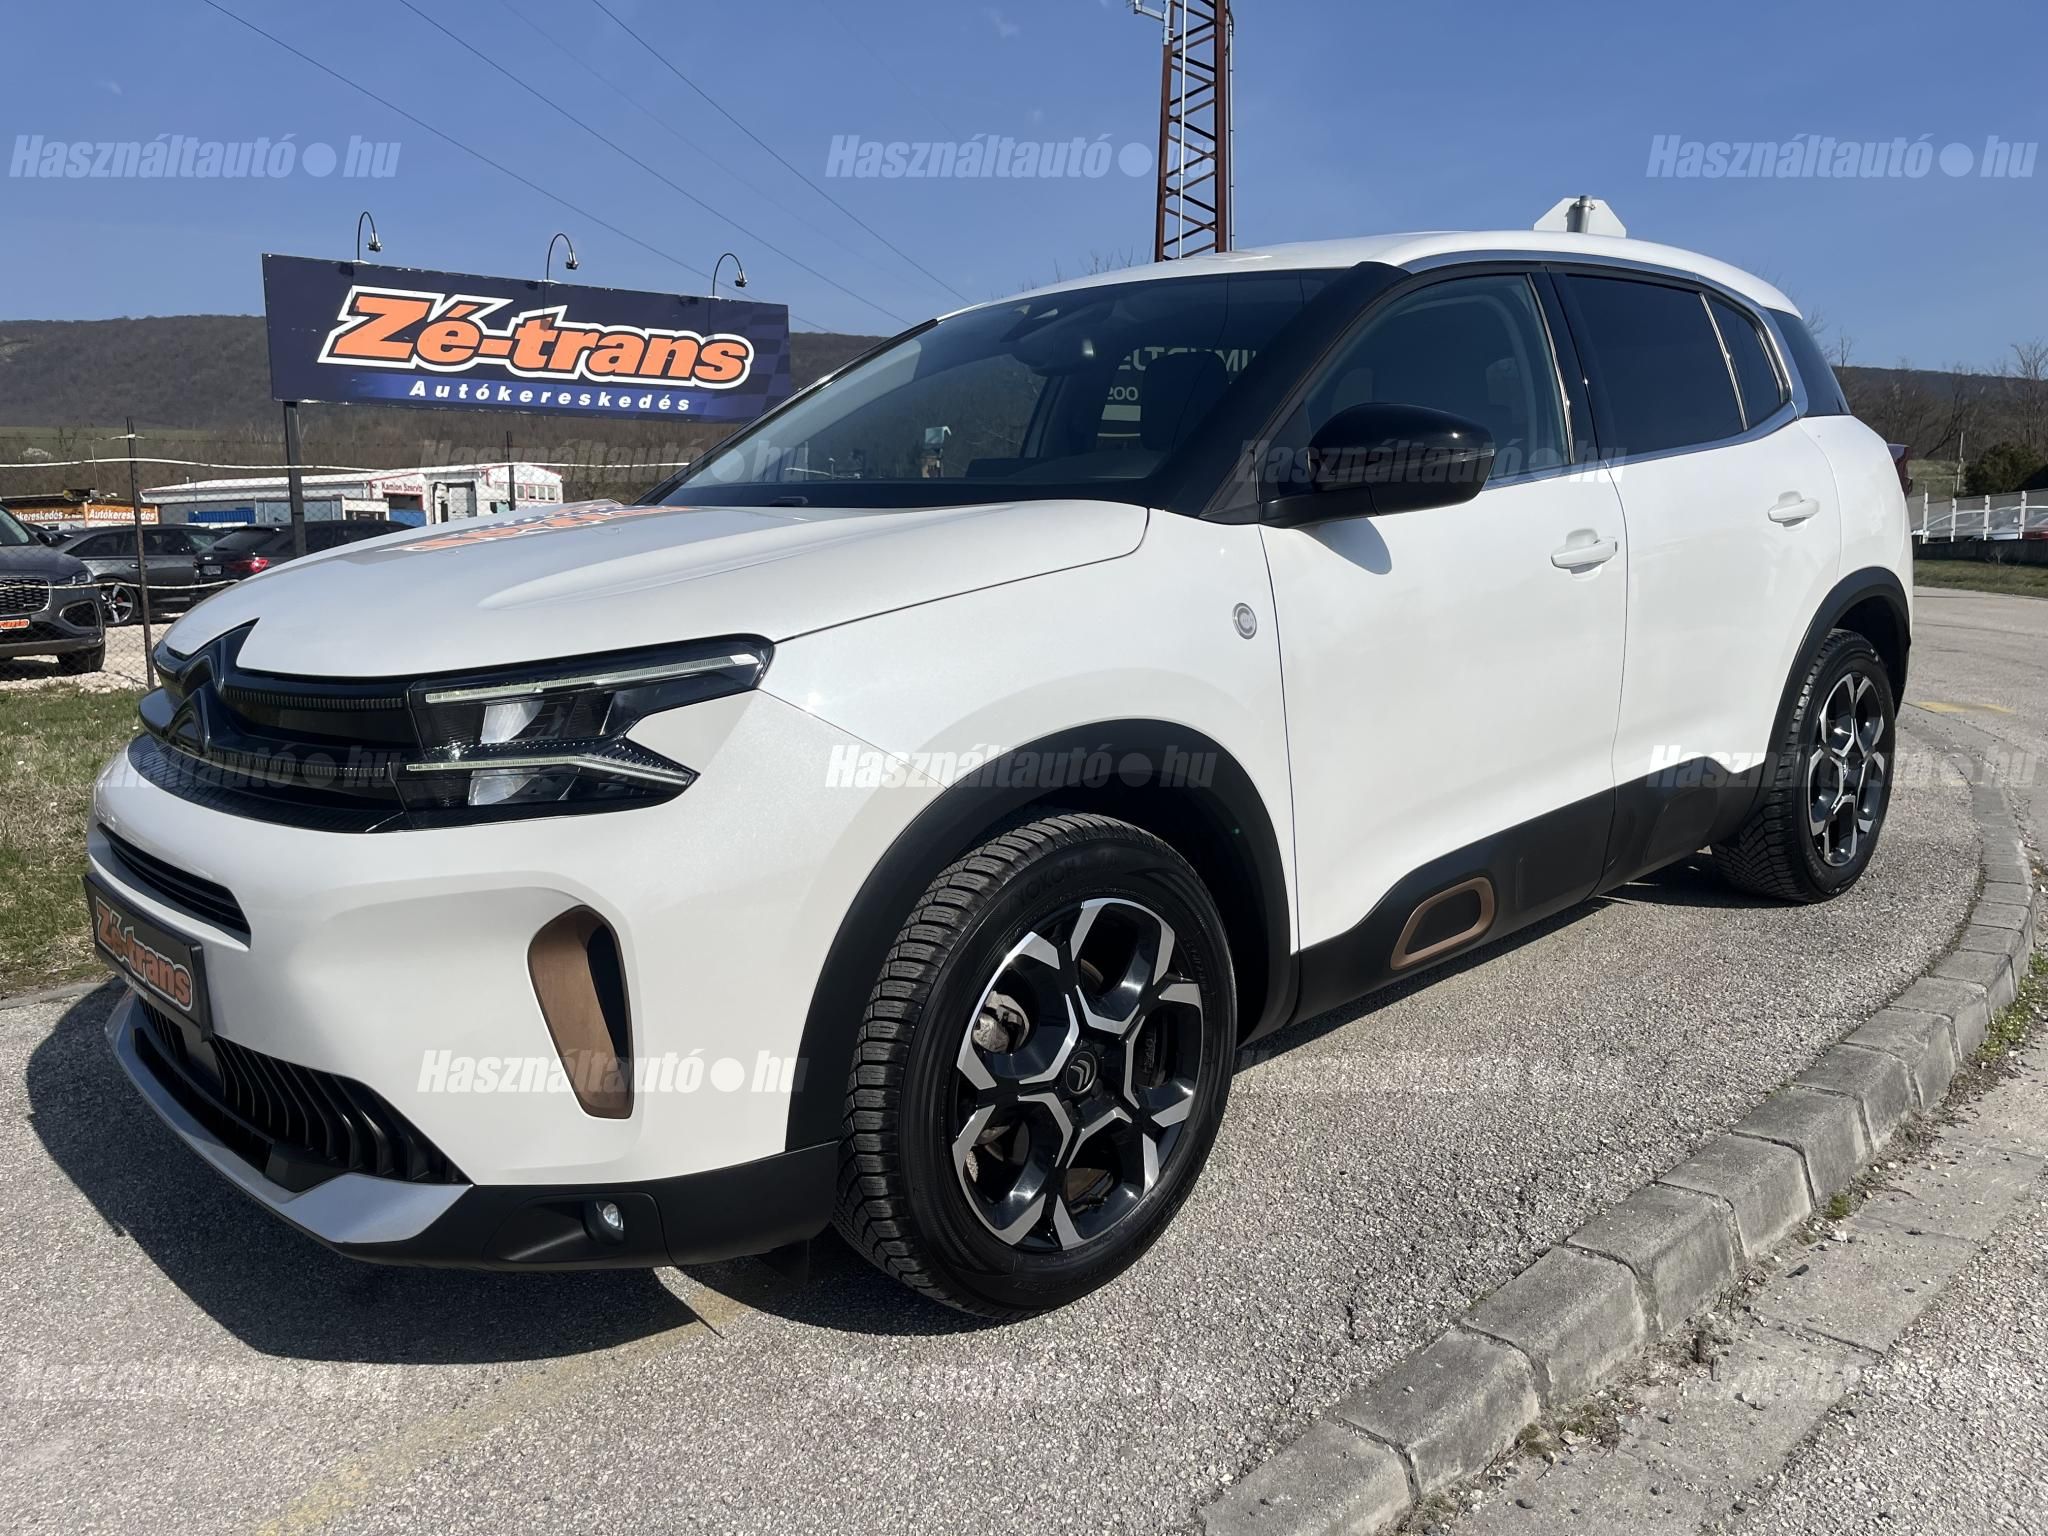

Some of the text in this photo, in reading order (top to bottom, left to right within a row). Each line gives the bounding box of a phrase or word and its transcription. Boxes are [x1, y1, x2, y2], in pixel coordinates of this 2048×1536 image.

[322, 288, 753, 388] Zé-trans
[409, 379, 690, 412] Autókereskedés
[13, 510, 63, 522] ókereskedés
[88, 508, 156, 521] Autókereskdés
